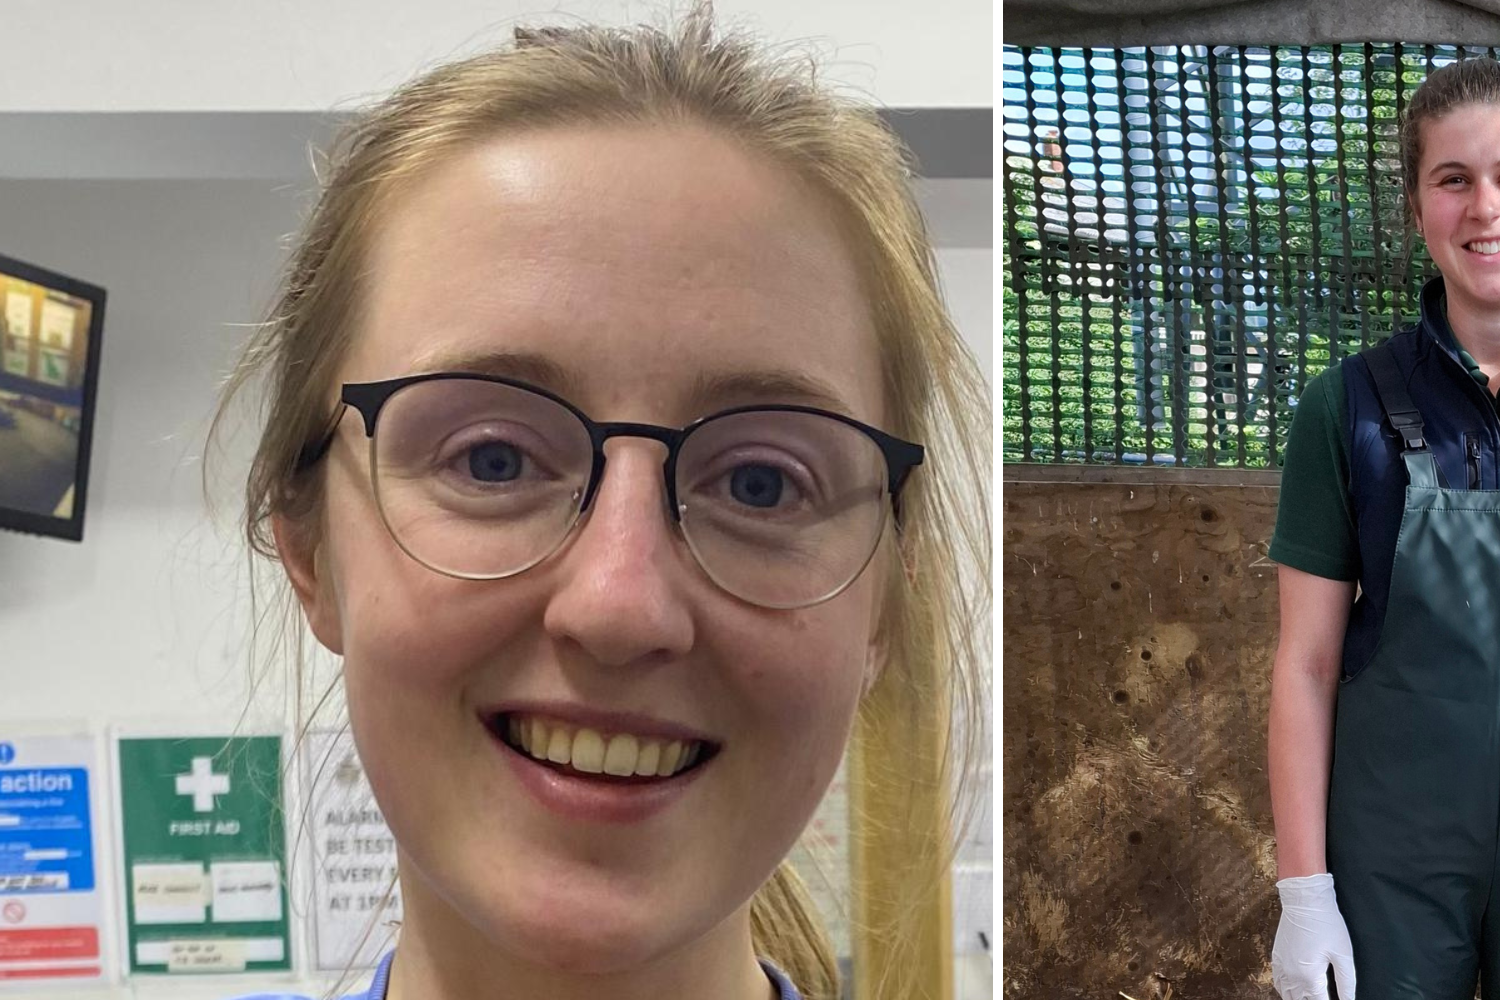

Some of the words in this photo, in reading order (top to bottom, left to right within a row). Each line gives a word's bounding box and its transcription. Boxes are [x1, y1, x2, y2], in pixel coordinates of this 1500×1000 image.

[0, 771, 73, 793] action
[169, 822, 211, 836] FIRST
[214, 820, 240, 835] AID
[327, 839, 349, 855] BE
[327, 867, 386, 884] EVERY
[329, 895, 351, 911] AT
